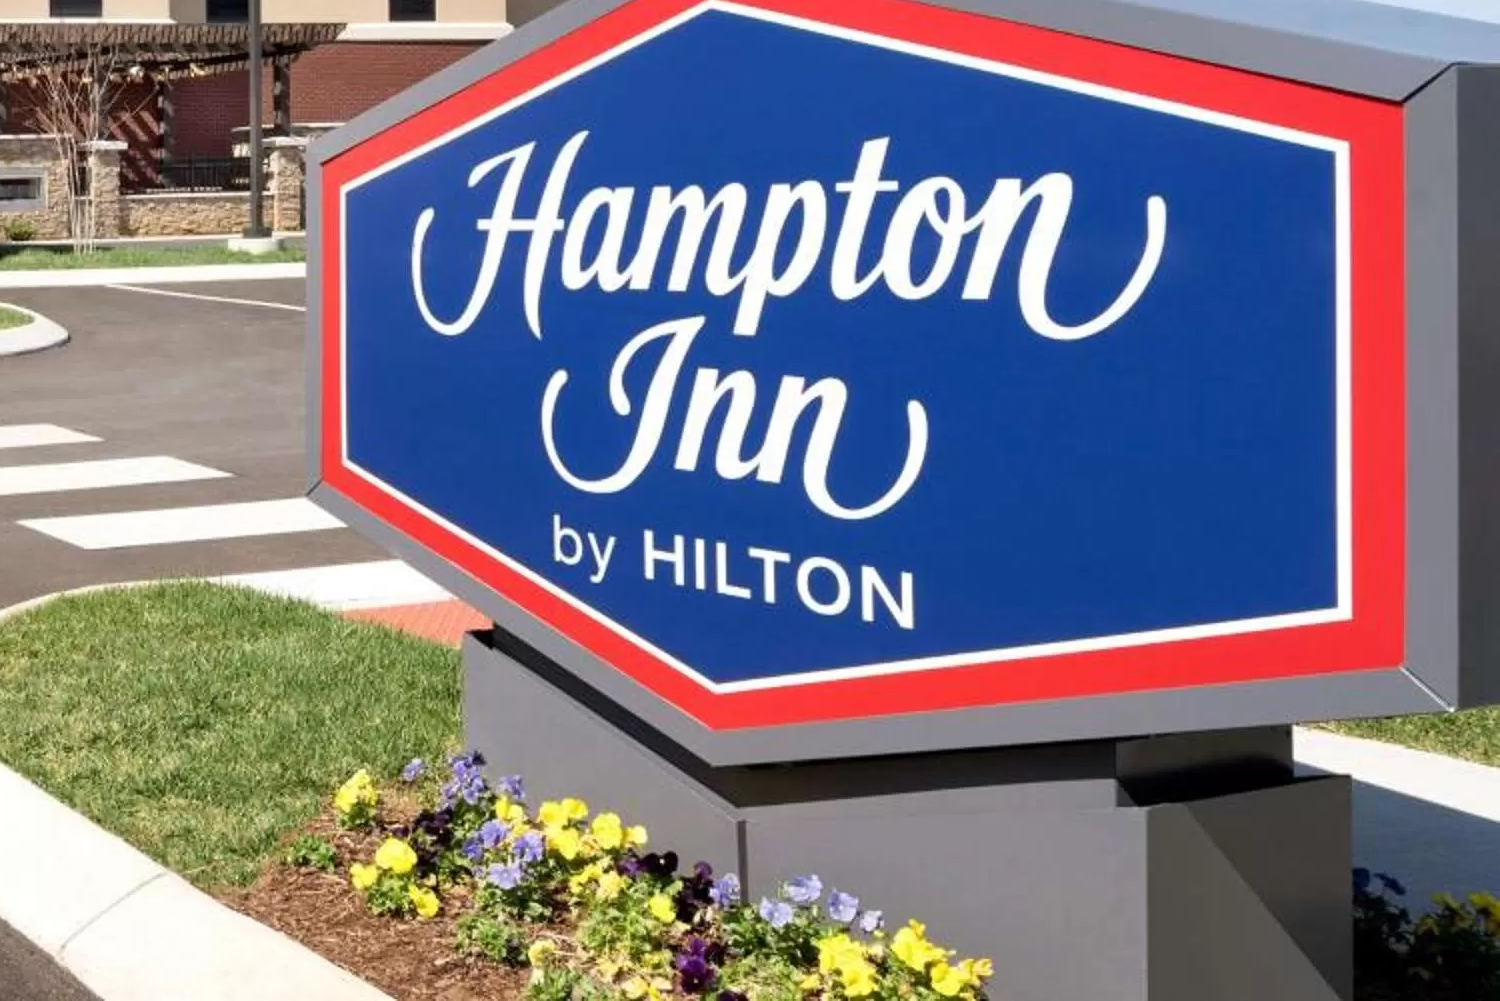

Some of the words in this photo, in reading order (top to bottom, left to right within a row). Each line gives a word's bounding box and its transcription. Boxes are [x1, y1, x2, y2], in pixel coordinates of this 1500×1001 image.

[412, 130, 1167, 341] Hampton
[541, 315, 928, 520] Inn
[553, 514, 616, 585] by
[643, 529, 915, 630] HILTON
